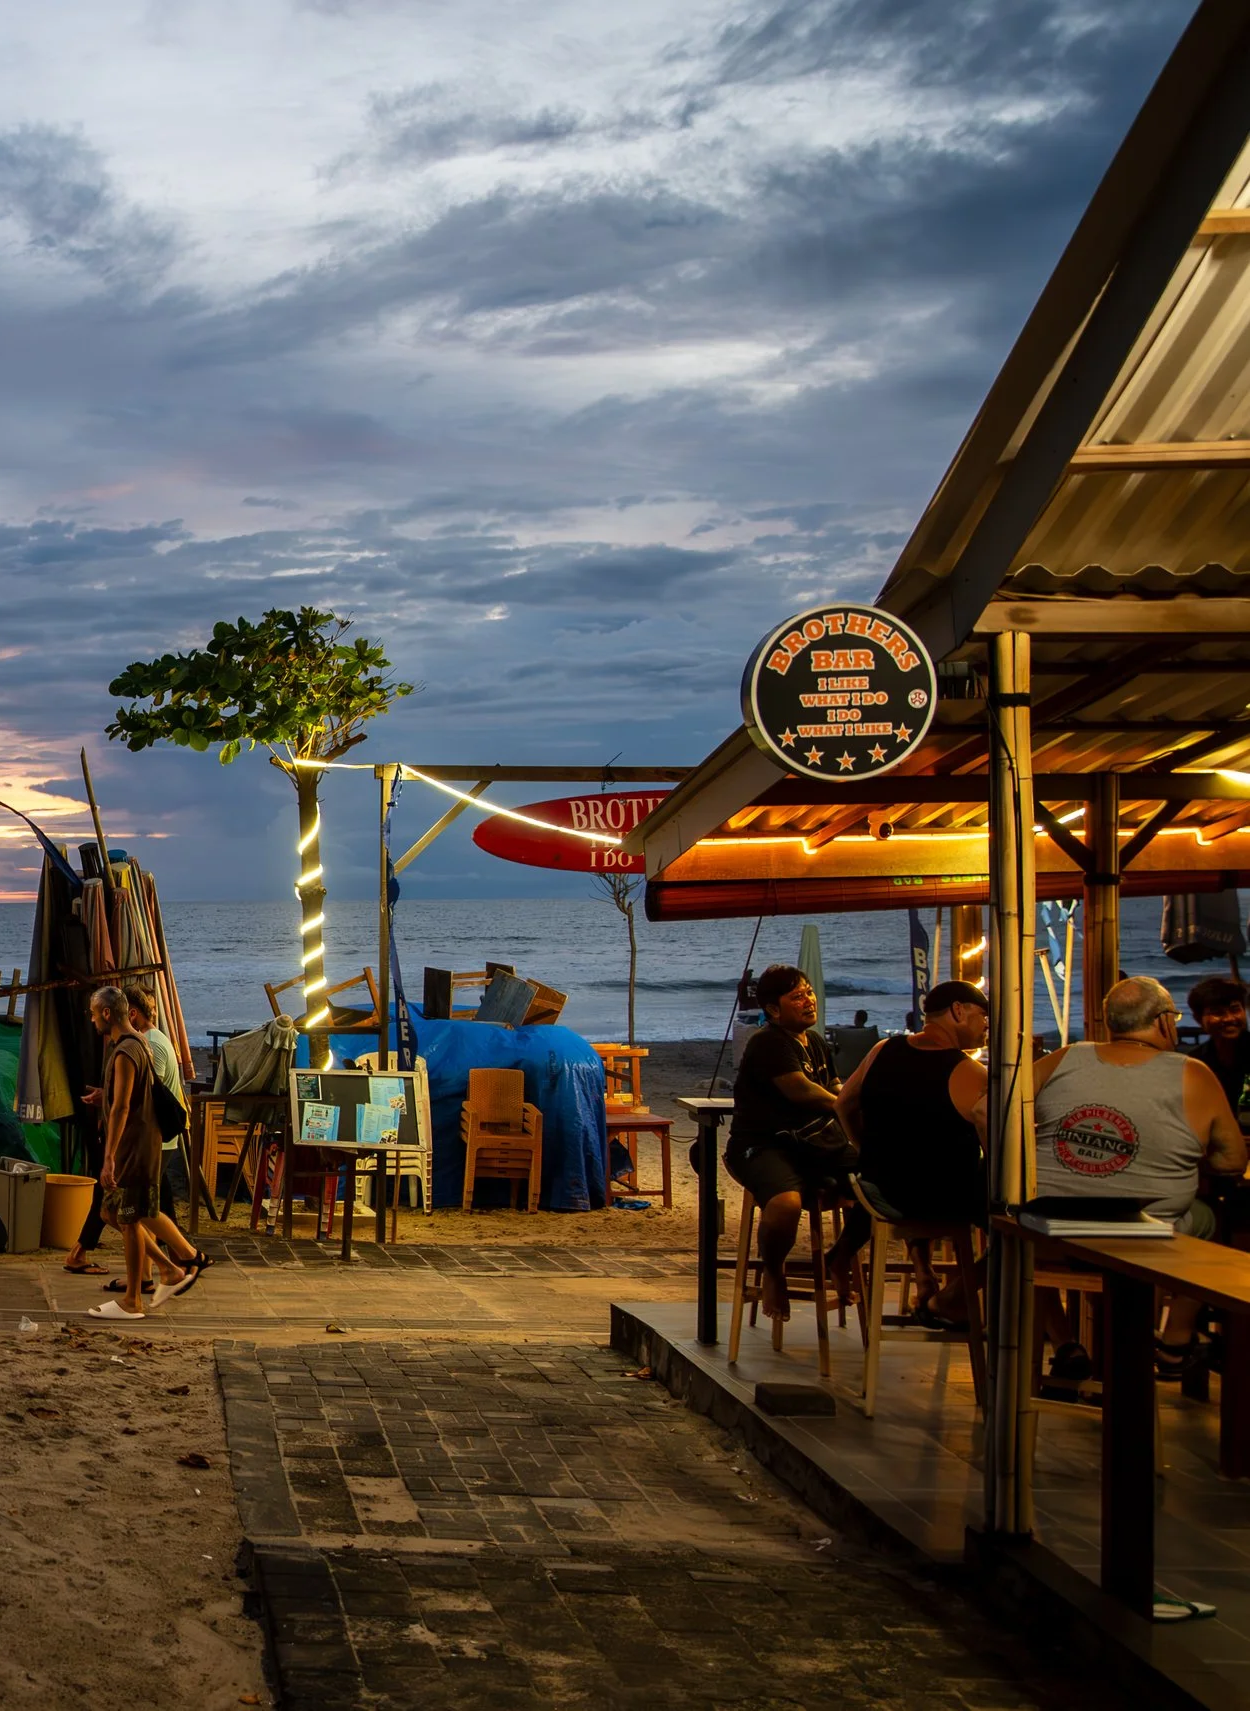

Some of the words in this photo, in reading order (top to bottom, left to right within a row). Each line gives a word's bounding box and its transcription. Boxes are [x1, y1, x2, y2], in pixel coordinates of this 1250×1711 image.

[766, 612, 921, 676] BROTHERS
[811, 649, 875, 672] BAR
[818, 678, 827, 691] I
[828, 676, 869, 690] LIKE
[799, 693, 850, 707] WHAT
[852, 693, 861, 705] I
[862, 691, 888, 705] DO
[827, 709, 836, 722] I
[837, 708, 861, 721] DO
[797, 724, 844, 737] WHAT
[845, 723, 853, 736] I
[854, 722, 893, 736] LIKE
[591, 851, 596, 867] I
[1058, 1130, 1127, 1153] BINTANG
[1077, 1147, 1104, 1160] BALI
